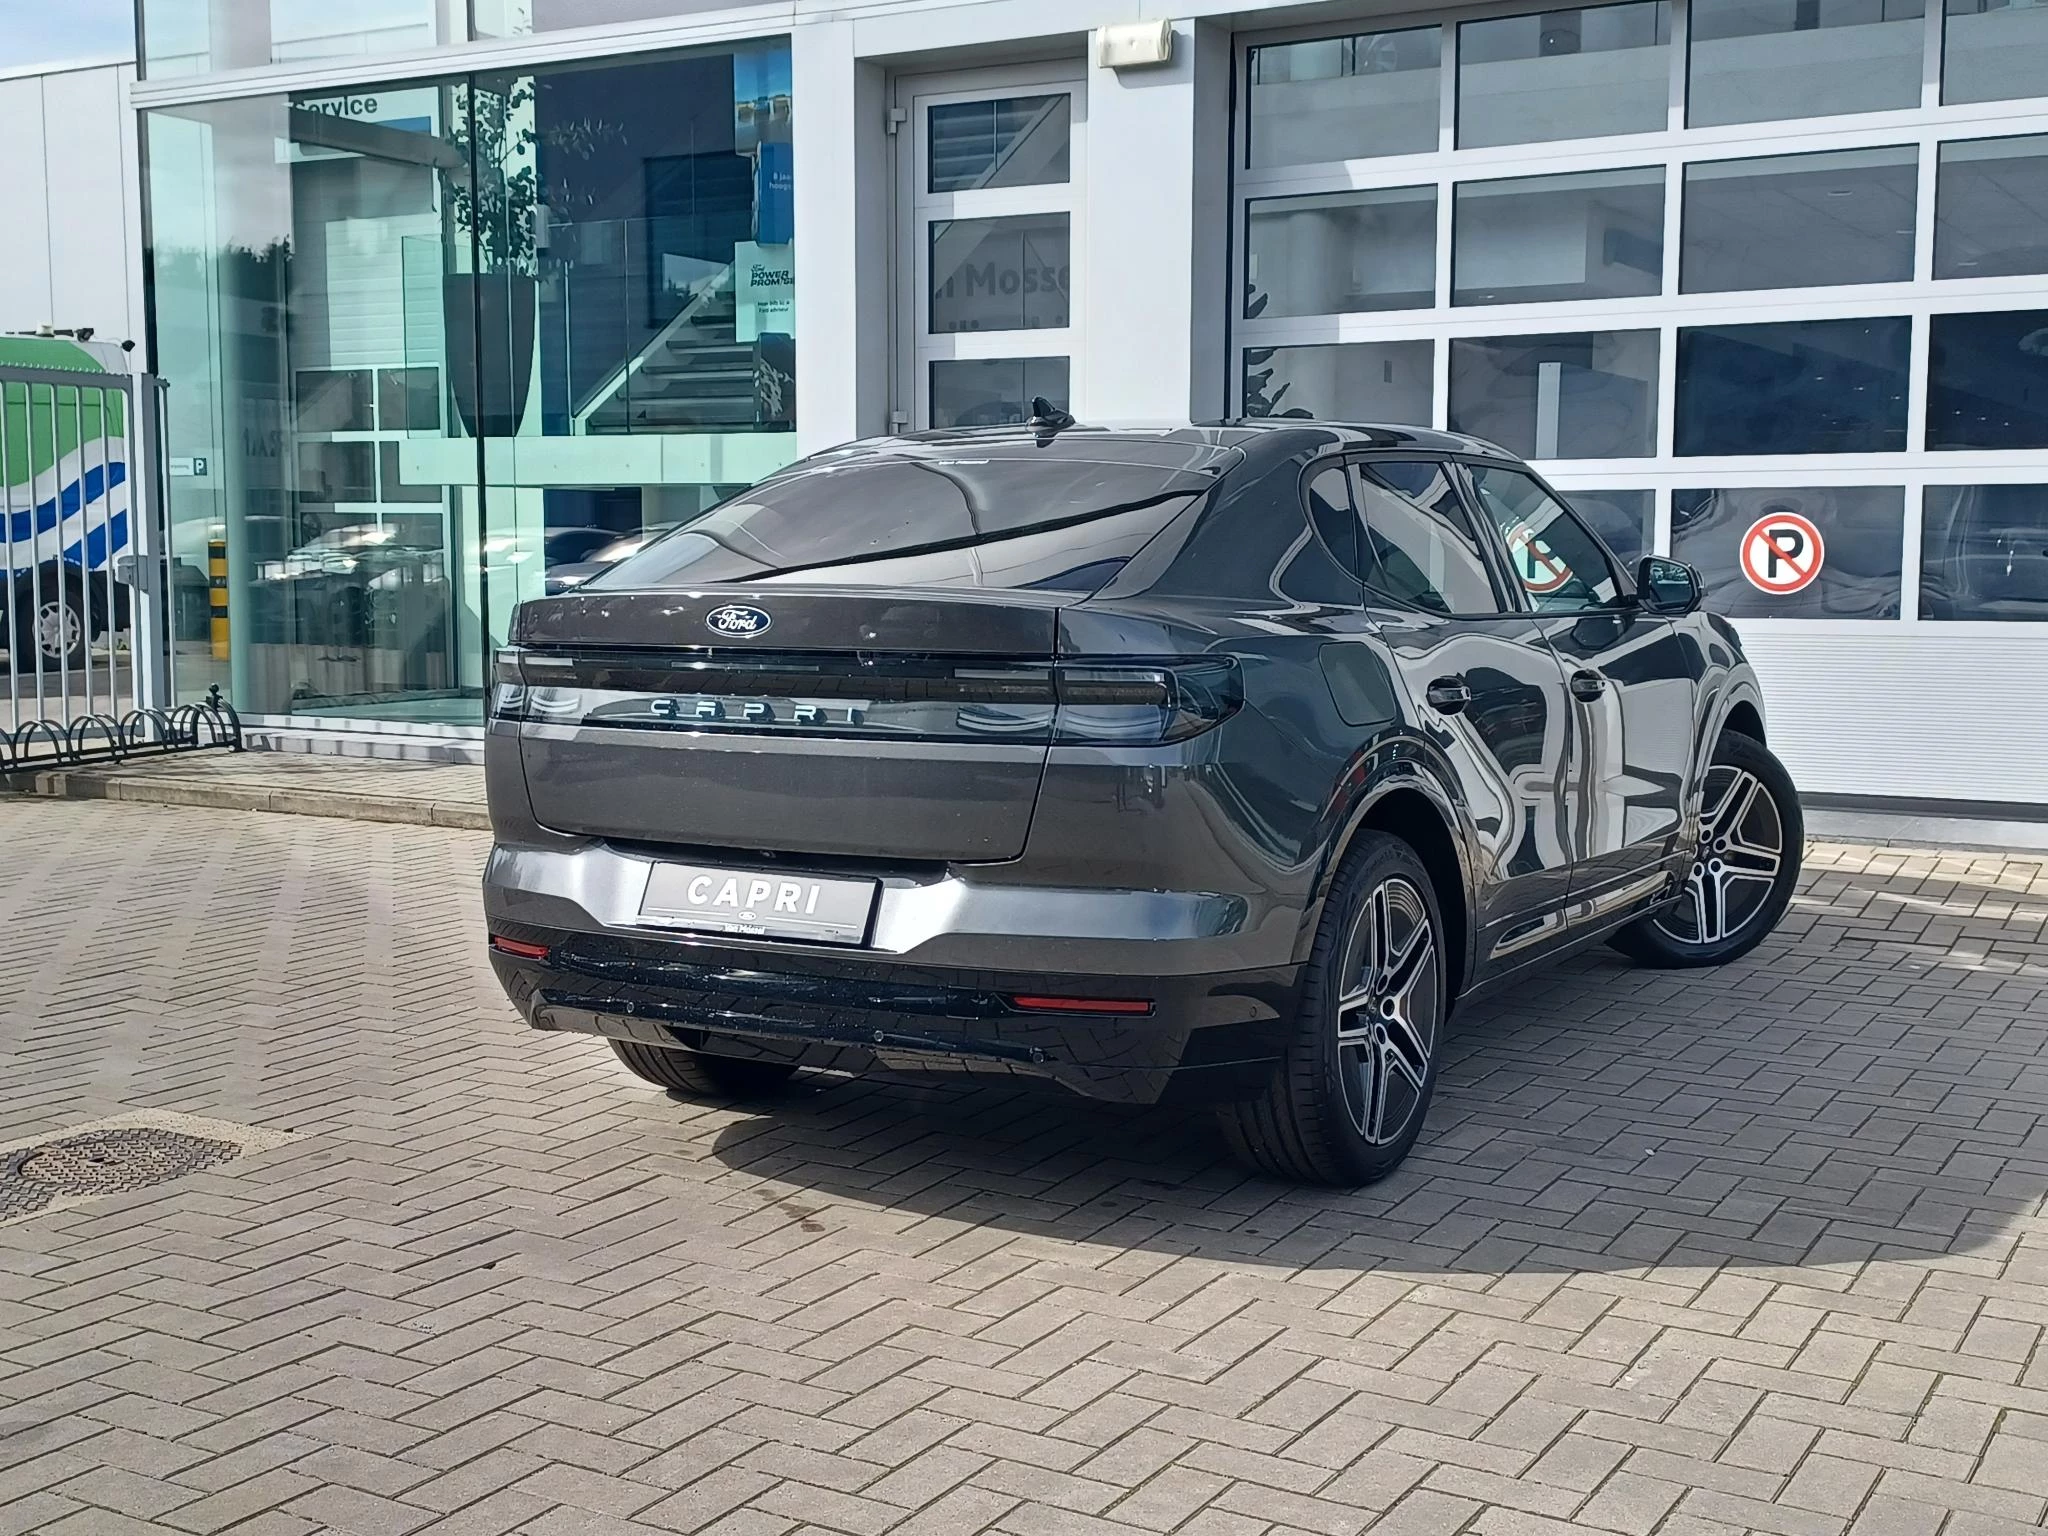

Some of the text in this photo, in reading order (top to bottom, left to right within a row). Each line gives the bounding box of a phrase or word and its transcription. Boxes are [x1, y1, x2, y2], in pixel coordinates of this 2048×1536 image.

[752, 269, 789, 280] POWER
[1768, 529, 1804, 578] P
[651, 699, 853, 722] CAPRI
[687, 875, 821, 915] CAPRI
